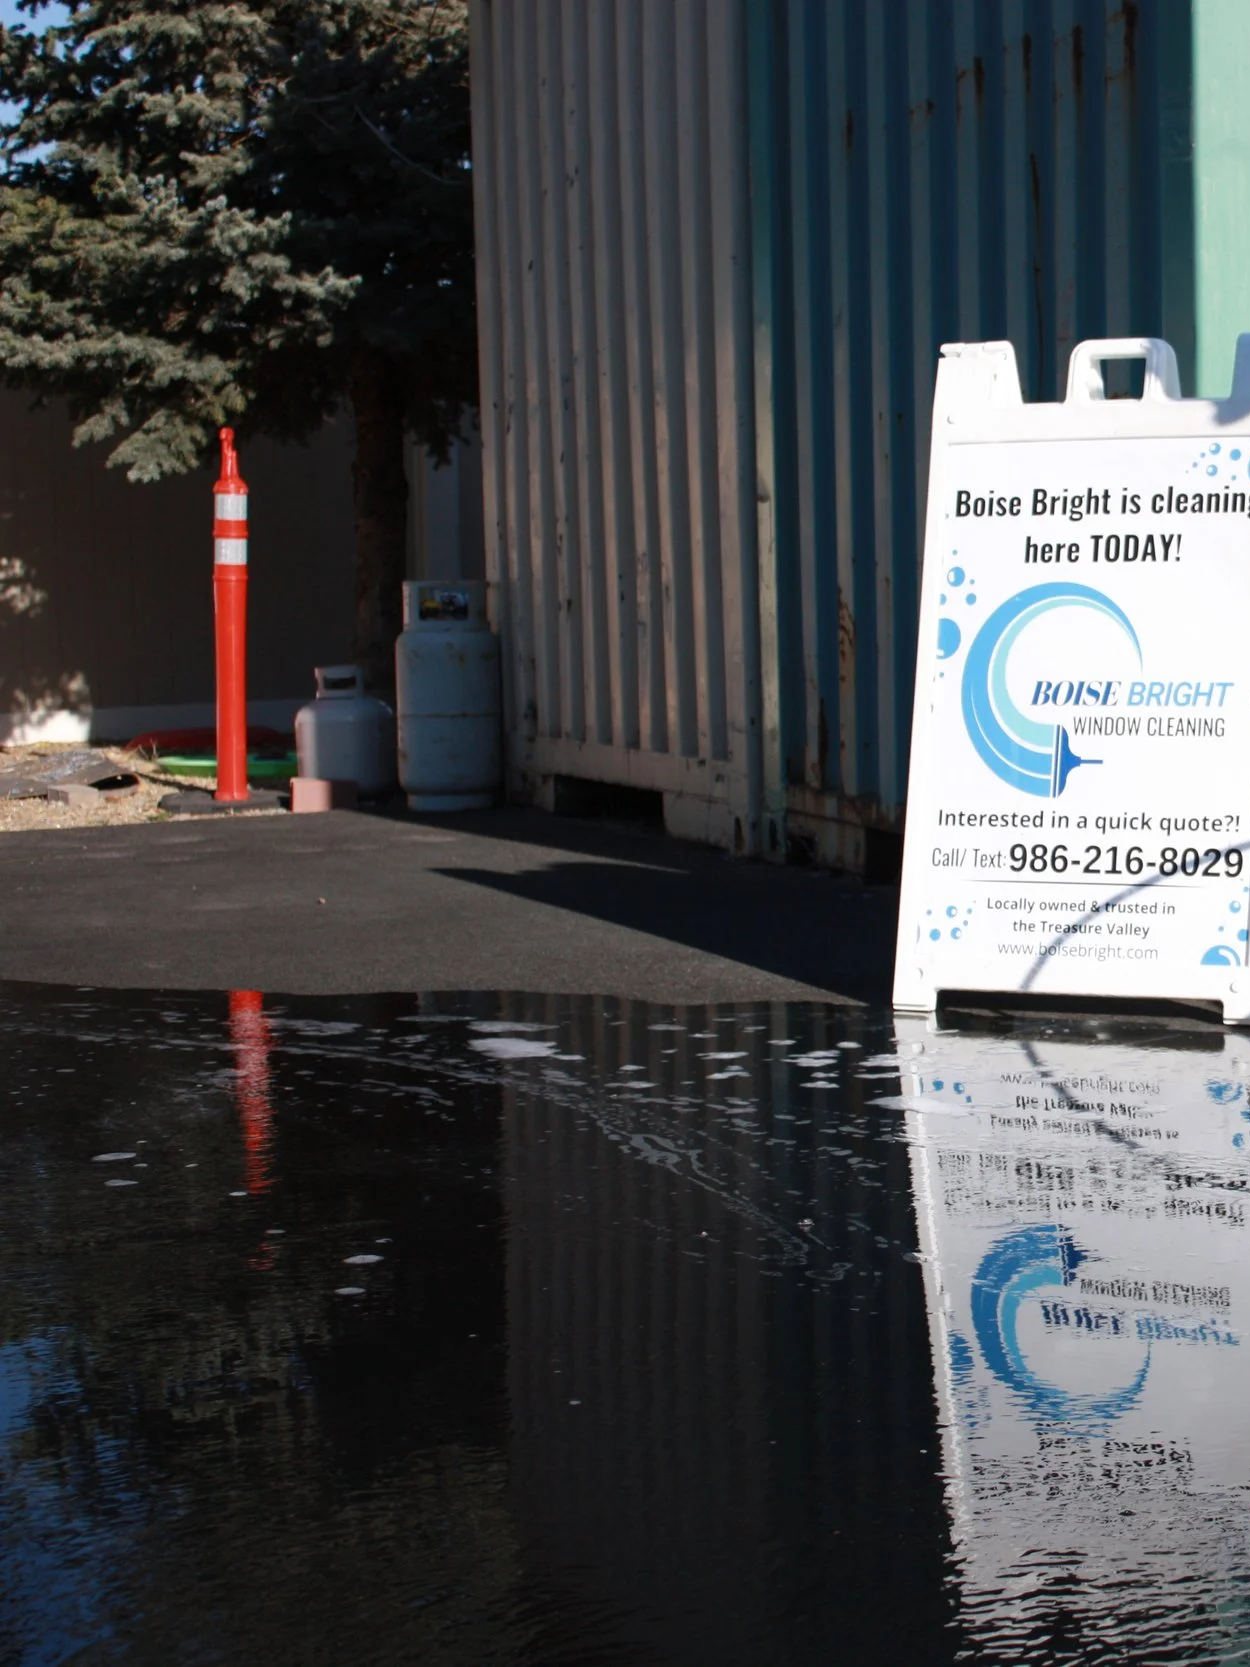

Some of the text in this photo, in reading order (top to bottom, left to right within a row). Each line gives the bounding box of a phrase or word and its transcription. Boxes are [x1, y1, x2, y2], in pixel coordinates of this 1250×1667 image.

[955, 490, 1021, 518] Boise
[1031, 487, 1111, 522] Bright
[1121, 487, 1141, 515] is
[1025, 533, 1182, 563] here TODAY!
[1031, 680, 1234, 707] BOISE BRIGHT
[1073, 716, 1225, 737] WINDOW CLEANING
[938, 809, 1240, 836] Interested in a quick quote?!
[932, 843, 1244, 878] Call/ Text: 986-216-8029
[987, 897, 1176, 915] Locally owned & trusted in
[1013, 920, 1150, 939] the Treasure Valley
[998, 942, 1158, 962] www.boisebright.com
